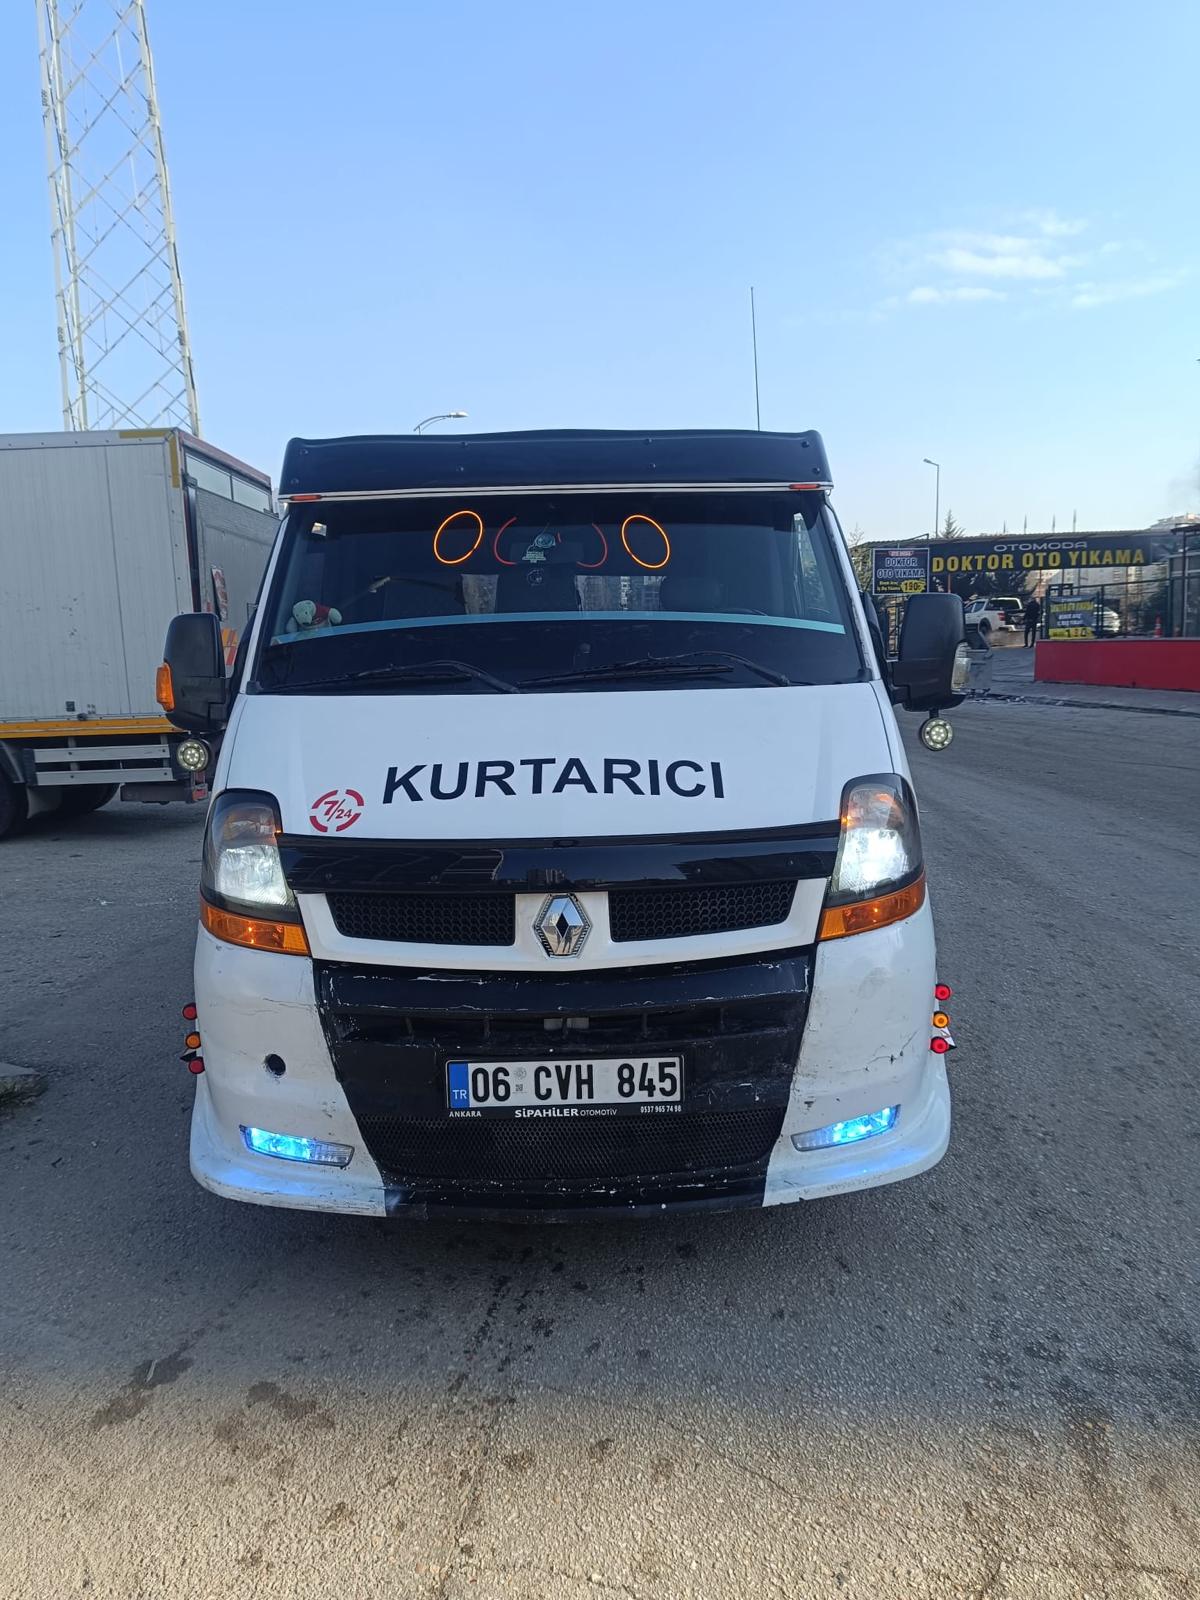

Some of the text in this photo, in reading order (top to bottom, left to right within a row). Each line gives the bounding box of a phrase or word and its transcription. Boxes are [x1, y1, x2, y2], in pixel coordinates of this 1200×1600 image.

[993, 541, 1088, 552] OTOMODA
[884, 557, 918, 568] DOKTOR
[931, 549, 1145, 573] DOKTOR OTO YIKAMA
[876, 568, 926, 579] OTO YIKAMA
[382, 757, 725, 805] KURTARICI
[323, 799, 352, 822] 7/24
[452, 1061, 677, 1104] TR 06 CVH 845
[449, 1110, 482, 1118] ANKARA
